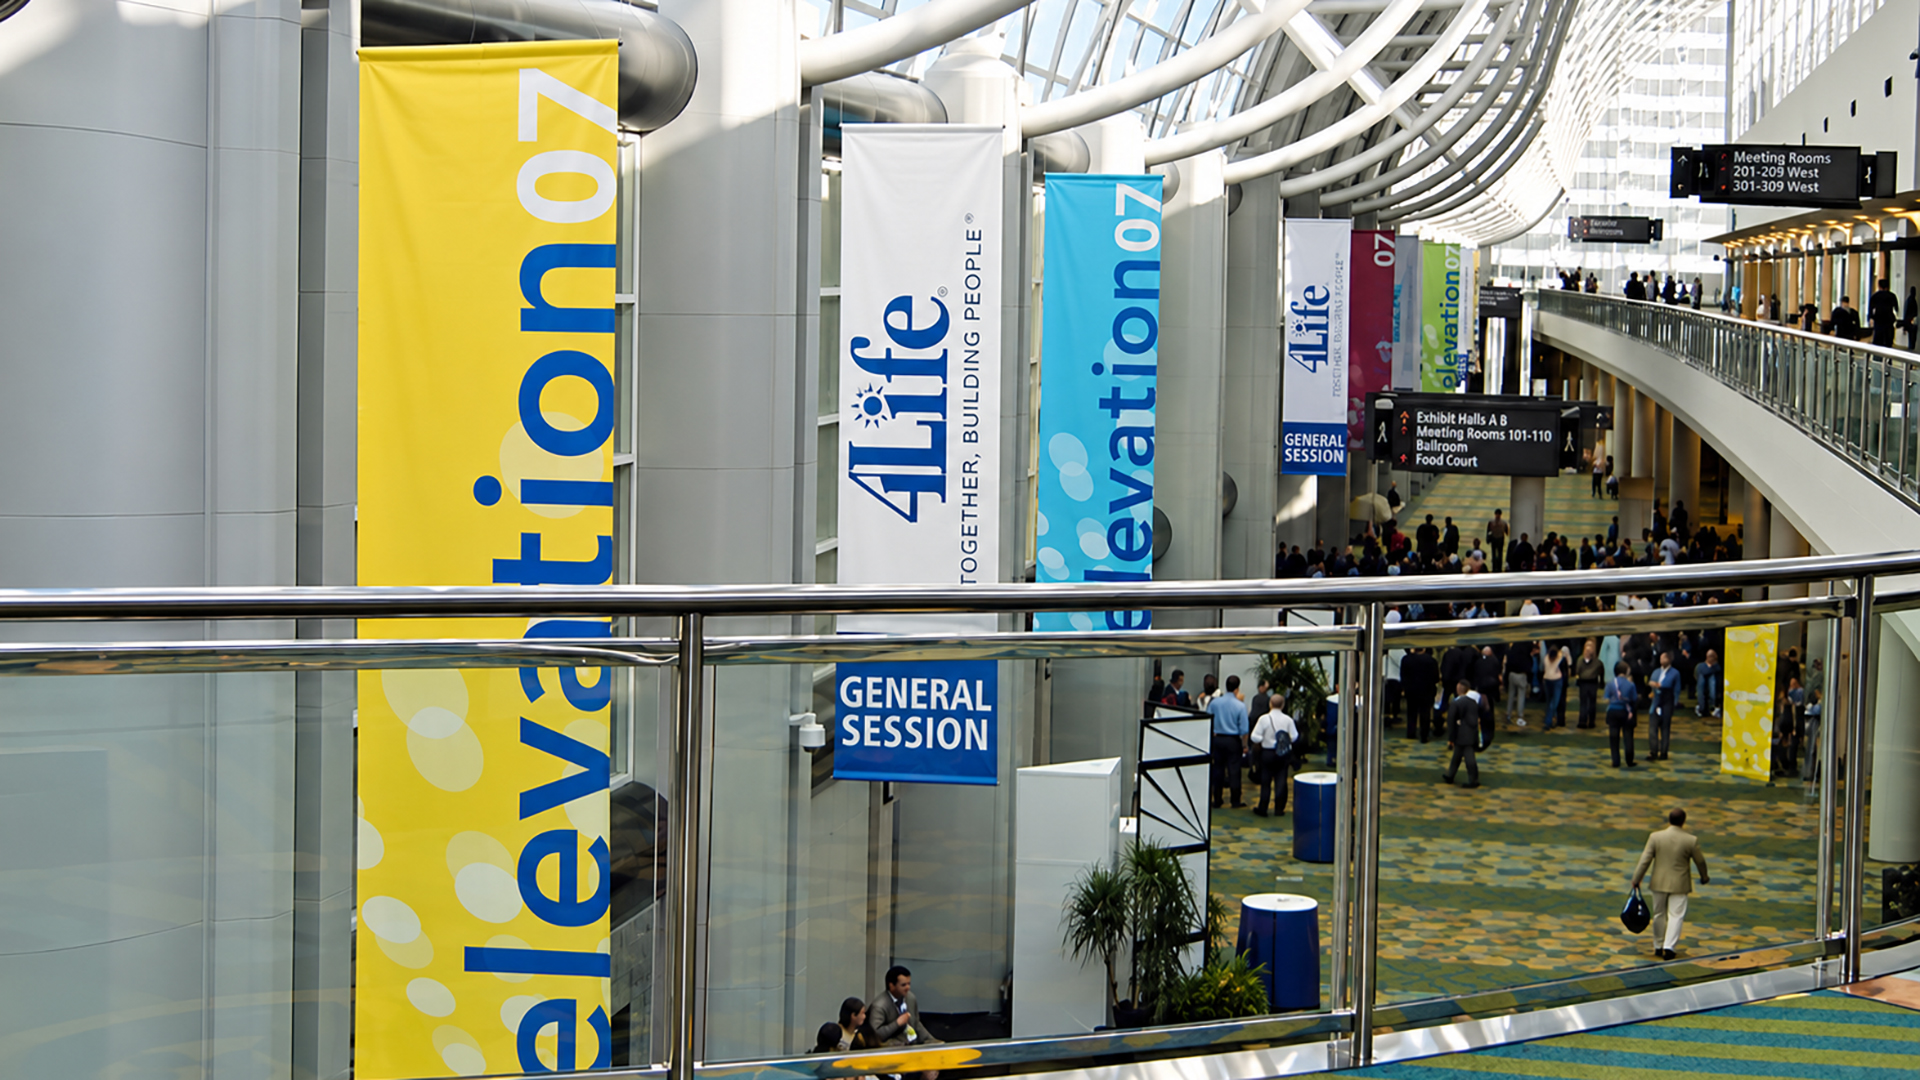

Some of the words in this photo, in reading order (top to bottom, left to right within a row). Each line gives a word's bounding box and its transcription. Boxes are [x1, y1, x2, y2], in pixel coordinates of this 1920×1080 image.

[1733, 151, 1786, 166] Meeting
[1788, 152, 1832, 165] Rooms
[1733, 165, 1785, 178] 201-209
[1787, 166, 1819, 179] West
[1733, 180, 1785, 192] 301-309
[1787, 181, 1819, 193] West
[1288, 285, 1331, 374] 4Life
[962, 331, 981, 444] BUILDING
[848, 295, 950, 524] 4Life
[1416, 411, 1456, 425] Exhibit
[1458, 413, 1486, 426] Halls
[1488, 413, 1498, 426] A
[1500, 414, 1508, 427] B
[1284, 432, 1345, 448] GENERAL
[1416, 425, 1464, 441] Meeting
[1466, 427, 1506, 441] Rooms
[1508, 429, 1552, 442] 101-110
[1416, 439, 1468, 453] Ballroom
[1285, 448, 1344, 463] SESSION
[1416, 453, 1444, 466] Food
[1446, 454, 1478, 467] Court
[960, 452, 981, 585] TOGETHER,
[840, 675, 992, 711] GENERAL
[842, 714, 988, 751] SESSION
